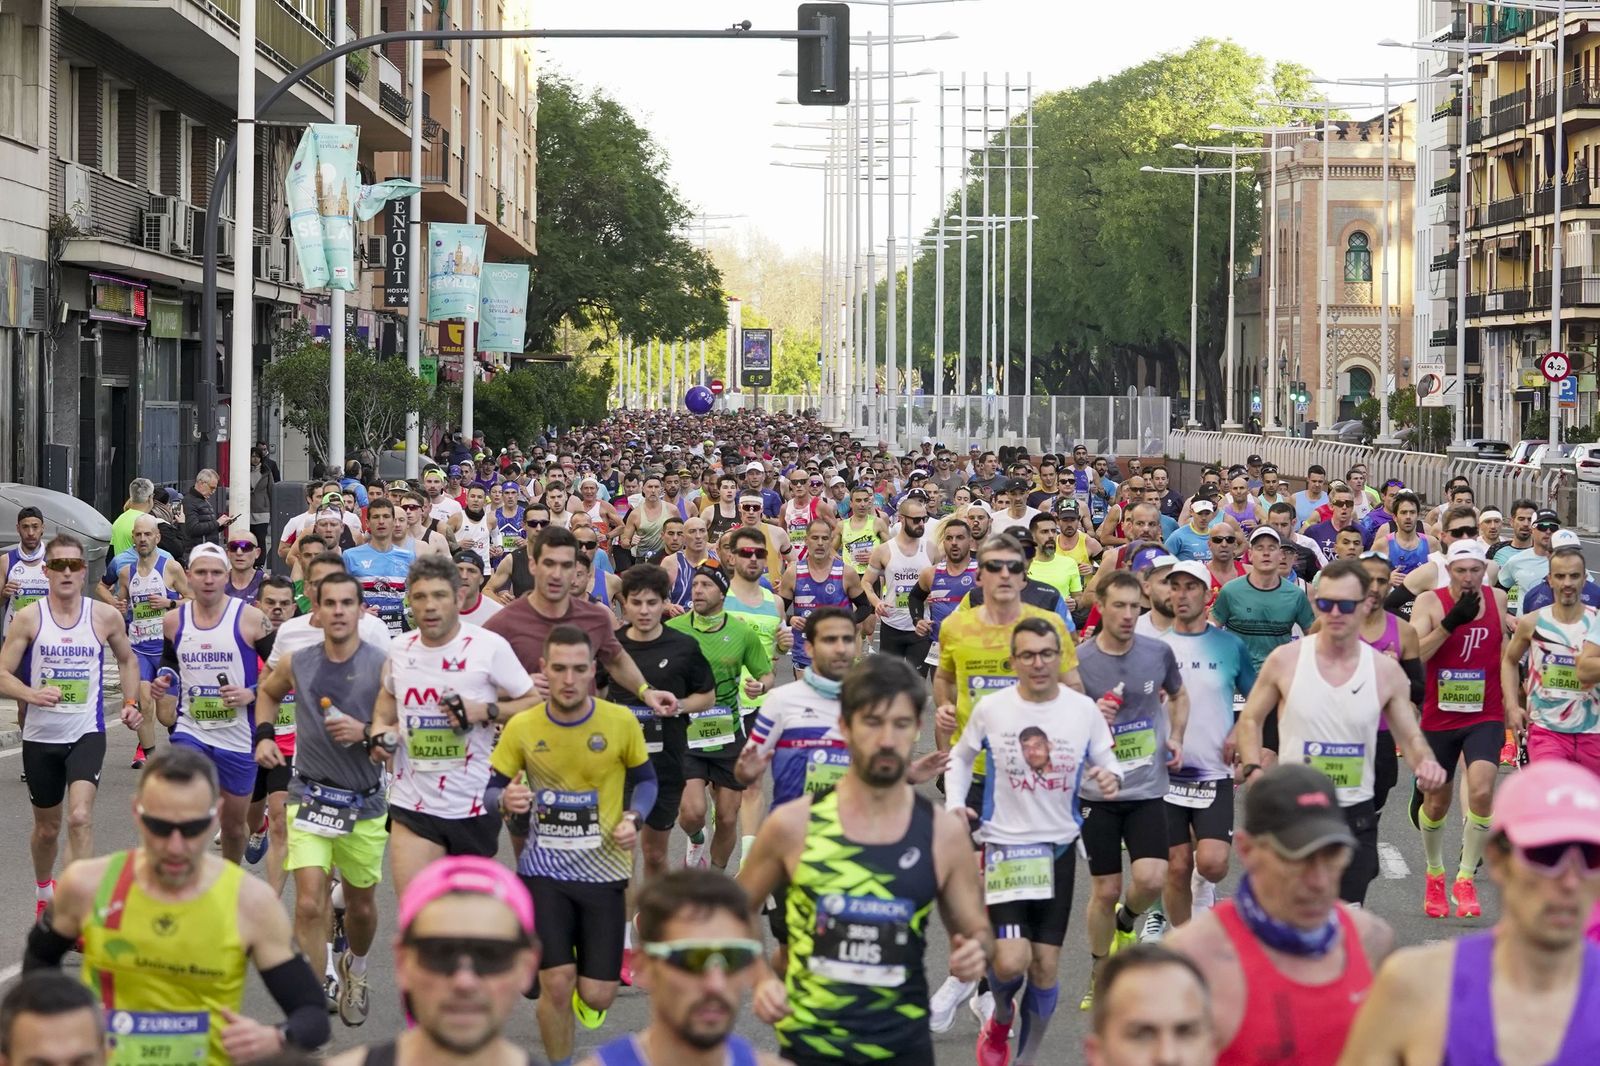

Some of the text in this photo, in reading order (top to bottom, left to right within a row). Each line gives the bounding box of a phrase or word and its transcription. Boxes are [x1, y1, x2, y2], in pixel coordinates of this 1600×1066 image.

[392, 196, 407, 284] ENTOFT
[136, 609, 162, 618] CLAUDIO
[40, 645, 95, 657] BLACKBURN
[181, 652, 234, 663] BLACKBURN
[56, 670, 85, 678] ZURICH
[1453, 671, 1481, 680] ZURICH
[987, 678, 1018, 687] ZURIC
[1549, 677, 1580, 690] SIBARI
[1441, 693, 1482, 703] APARICIO
[195, 710, 230, 719] STUART
[423, 719, 451, 727] ZURIC
[1117, 720, 1147, 732] ZURICH
[698, 728, 722, 738] VEGA
[1114, 747, 1143, 760] MATT
[1325, 745, 1360, 754] ZURICH
[1187, 787, 1217, 798] MAZON
[557, 794, 592, 804] ZURICH
[307, 811, 345, 830] PABLO
[539, 823, 584, 837] RECACHA
[1006, 848, 1043, 858] ZURICH
[1003, 874, 1051, 889] FAMILIA
[837, 940, 883, 964] LUIS
[138, 1015, 199, 1032] ZURICH
